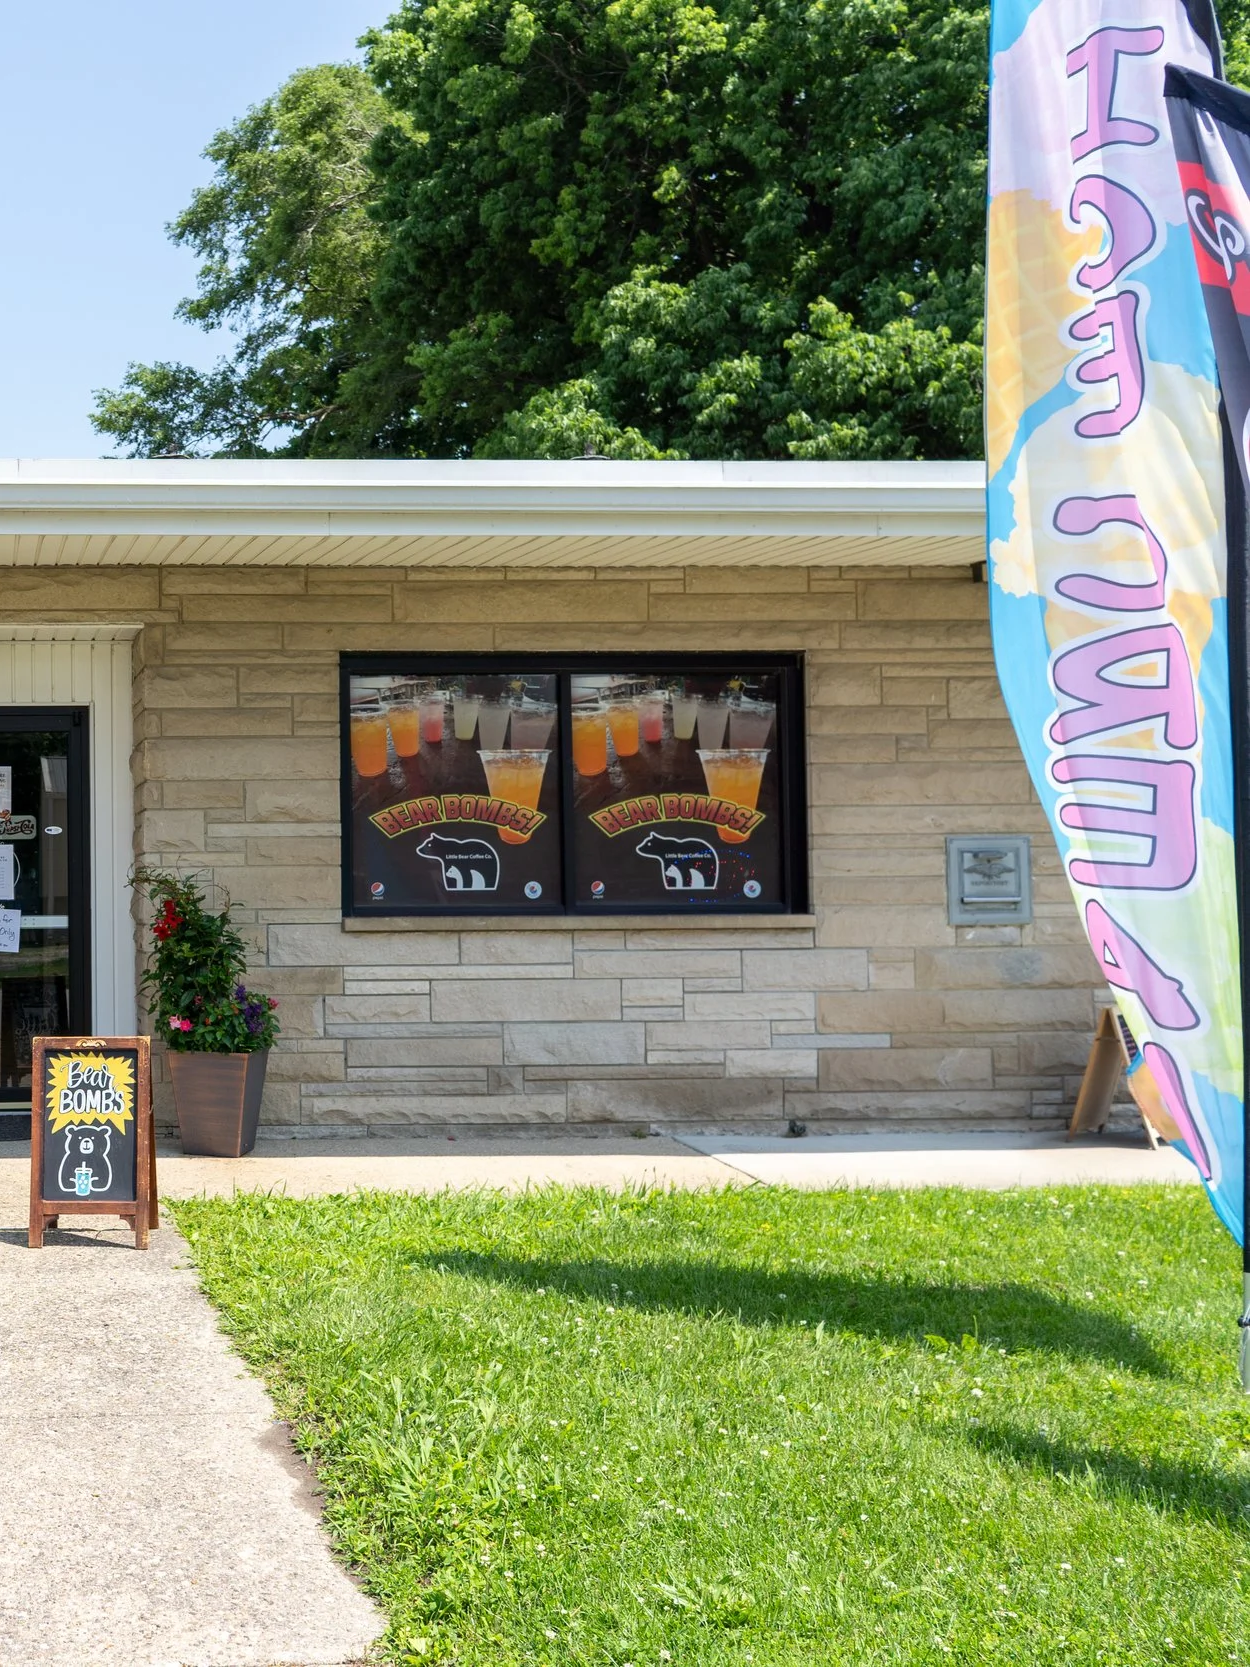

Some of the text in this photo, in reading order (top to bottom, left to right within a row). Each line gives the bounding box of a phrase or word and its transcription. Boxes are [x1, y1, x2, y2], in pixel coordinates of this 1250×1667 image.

[373, 795, 543, 836] BEAR BOMBS!
[593, 795, 763, 835] BEAR BOMBS!
[0, 927, 15, 942] Only
[60, 1060, 115, 1090] Bear
[59, 1088, 125, 1115] BOMBS
